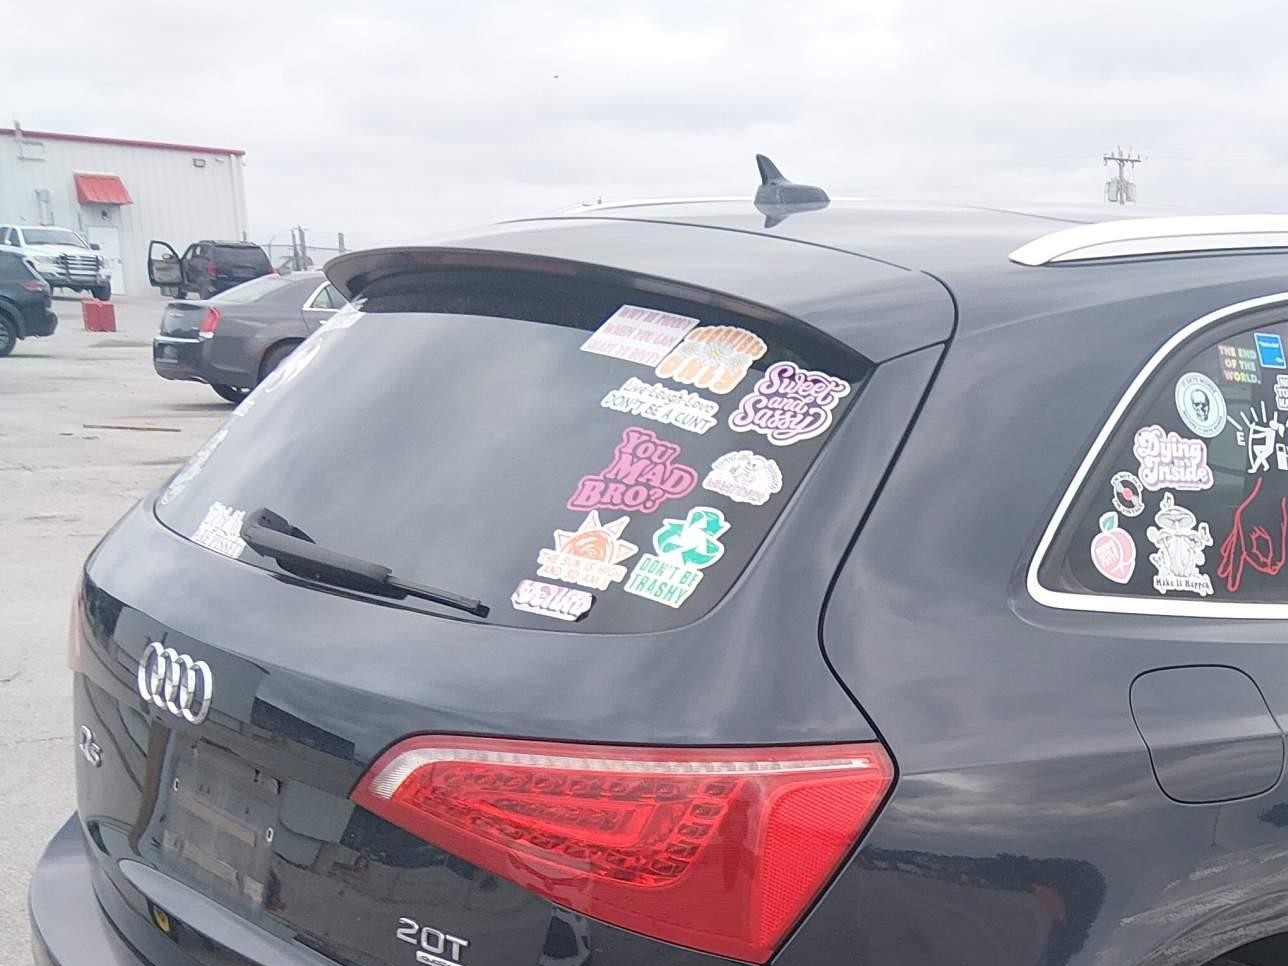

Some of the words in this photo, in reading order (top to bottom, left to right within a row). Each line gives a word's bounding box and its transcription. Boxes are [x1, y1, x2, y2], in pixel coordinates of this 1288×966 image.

[1218, 345, 1236, 357] THE
[1238, 348, 1257, 359] END
[1225, 359, 1237, 369] OF
[1239, 361, 1256, 371] THE
[761, 365, 845, 404] Sweet
[1224, 370, 1262, 384] WORLD.
[644, 403, 662, 416] BE
[662, 408, 674, 419] A
[675, 412, 712, 431] CUNT
[732, 398, 826, 440] Sassy
[772, 396, 809, 413] and
[622, 430, 678, 462] YOU
[1137, 429, 1202, 464] Dying
[605, 454, 693, 494] MAD
[1142, 459, 1209, 486] Inside
[573, 479, 666, 508] BRO?
[639, 557, 681, 577] DON'T
[680, 569, 700, 586] BE
[1156, 579, 1174, 588] Make
[1185, 580, 1209, 590] Happen
[631, 573, 689, 605] TRASHY
